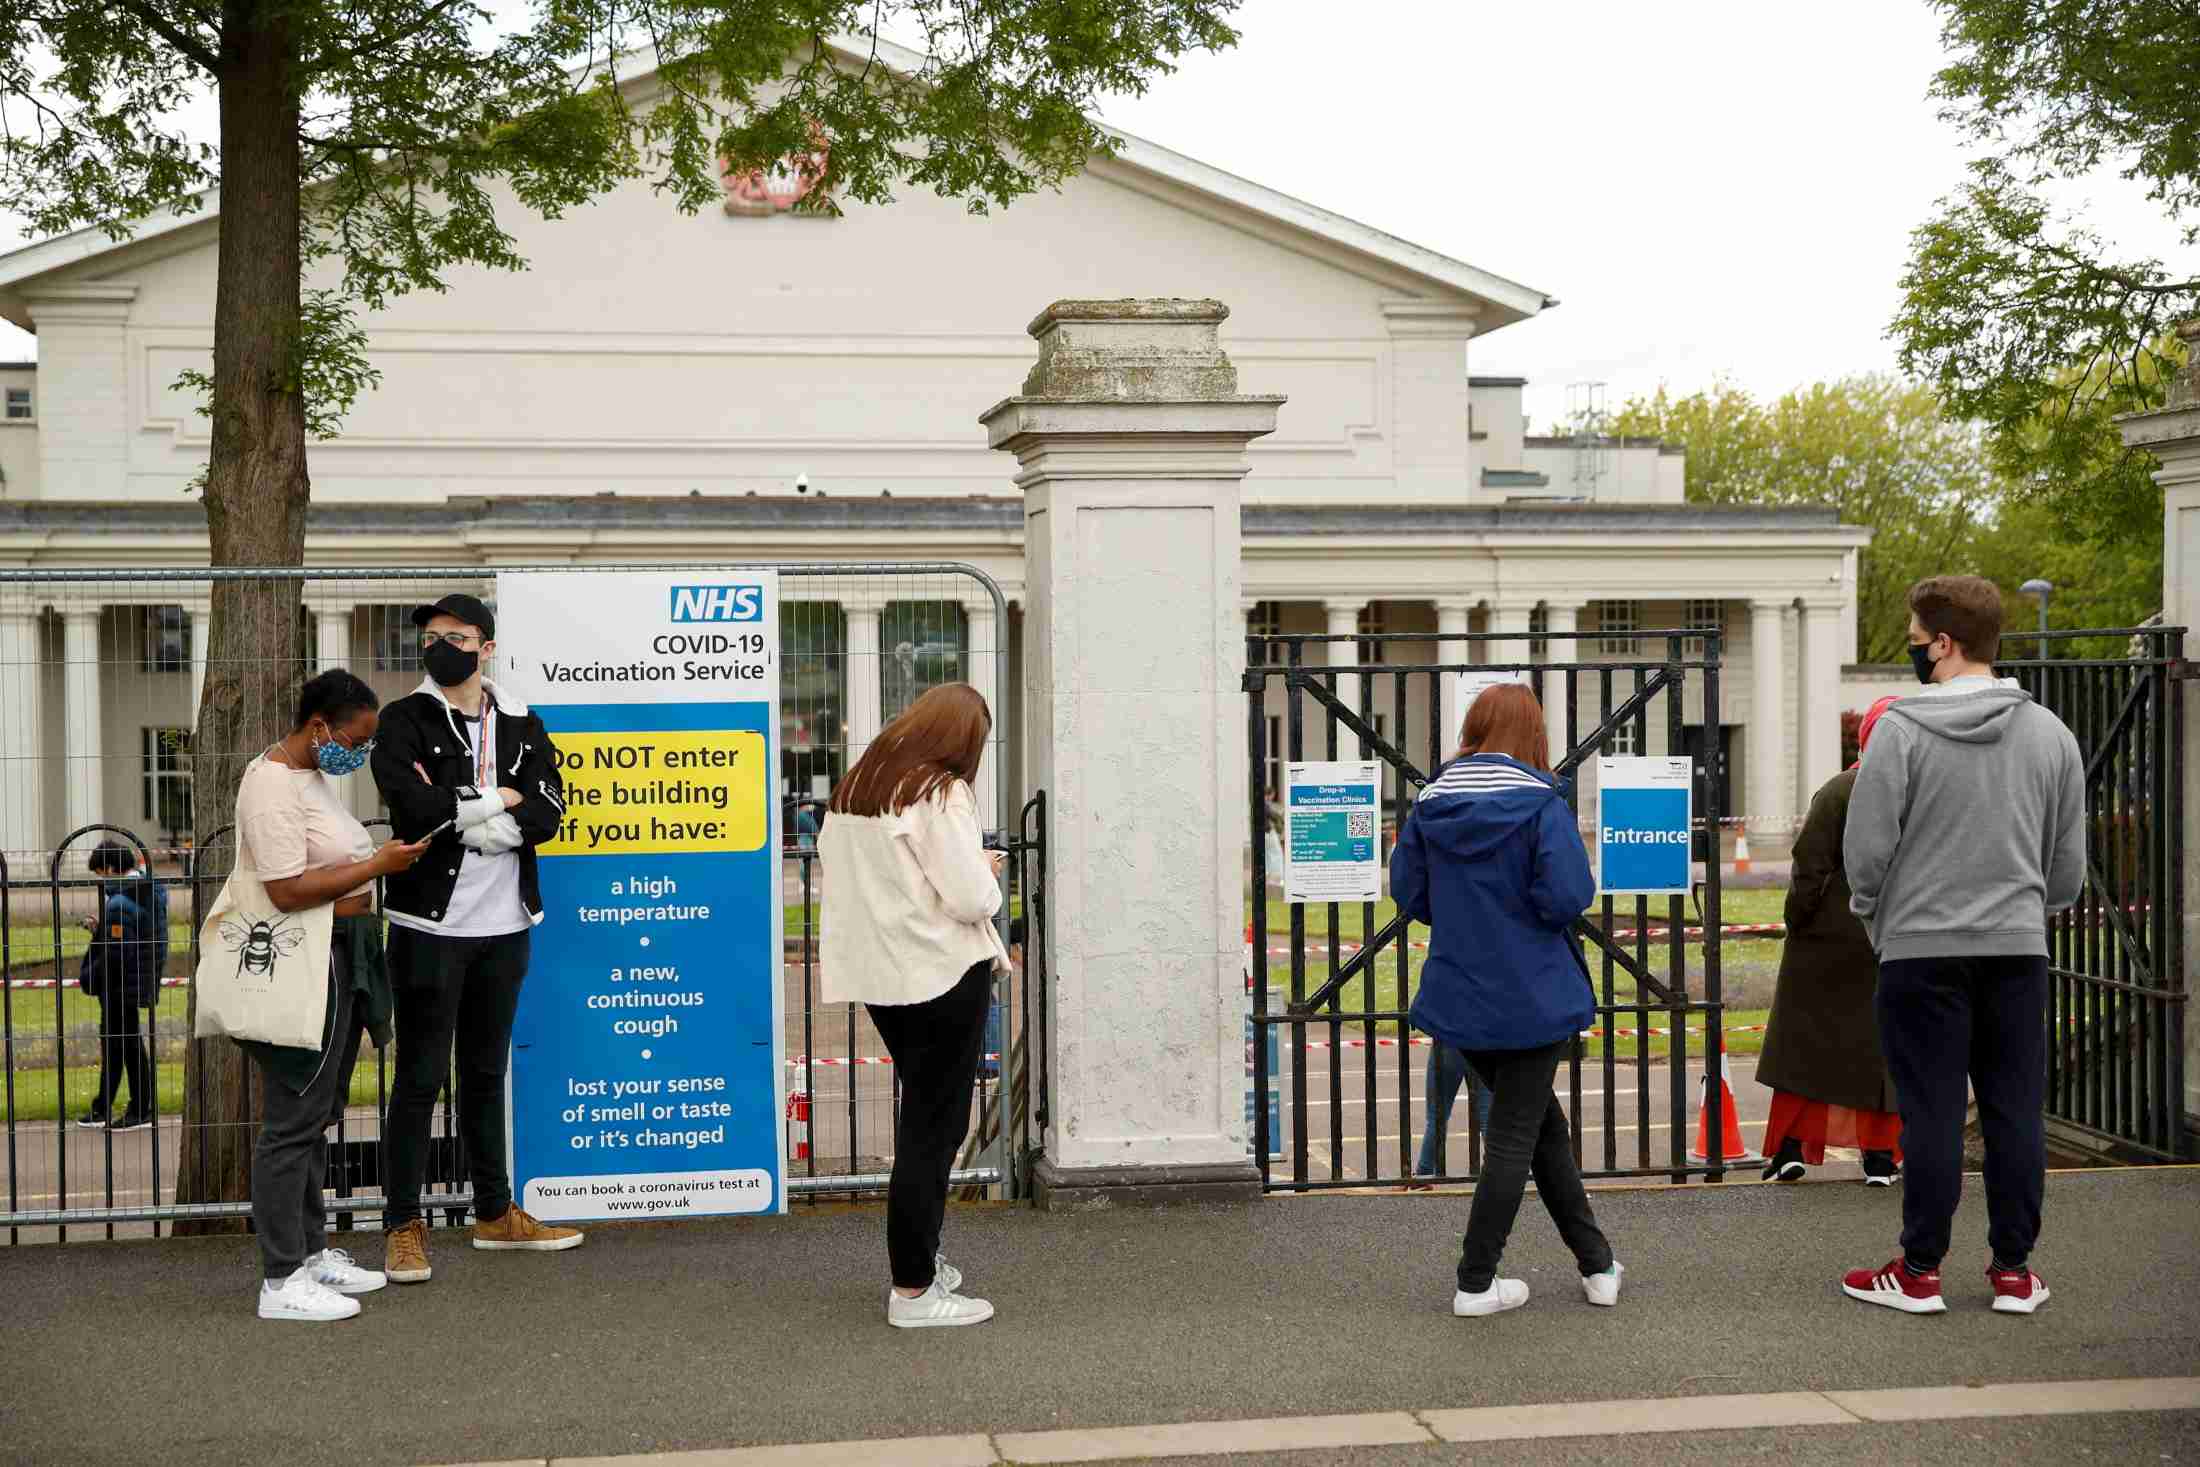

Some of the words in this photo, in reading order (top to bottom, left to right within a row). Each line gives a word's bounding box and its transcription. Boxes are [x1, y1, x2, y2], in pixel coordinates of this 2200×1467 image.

[672, 587, 758, 620] NHS
[653, 634, 764, 654] COVID-19
[542, 661, 675, 682] Vaccination
[684, 659, 764, 681] Service
[594, 746, 655, 768] NOT
[664, 743, 738, 767] enter
[562, 782, 601, 806] the
[612, 780, 728, 809] building
[1298, 796, 1340, 805] Vaccination
[1342, 795, 1367, 804] Clinics
[560, 817, 578, 842] if
[588, 822, 640, 848] you
[651, 816, 726, 841] have:
[1602, 827, 1688, 844] Entrance
[611, 881, 623, 895] a
[630, 876, 677, 898] high
[578, 905, 710, 925] temperature
[610, 968, 622, 981] a
[630, 966, 680, 982] new,
[587, 990, 704, 1008] continuous
[613, 1015, 678, 1037] cough
[568, 1079, 607, 1096] lost
[613, 1080, 661, 1099] your
[667, 1076, 726, 1093] sense
[563, 1104, 585, 1123] of
[591, 1103, 644, 1122] smell
[652, 1105, 674, 1120] or
[680, 1101, 732, 1118] taste
[571, 1134, 593, 1149] or
[635, 1125, 724, 1149] changed
[536, 1186, 561, 1197] You
[565, 1185, 587, 1196] can
[591, 1182, 624, 1195] book
[628, 1185, 636, 1194] a
[640, 1180, 715, 1194] coronavirus
[719, 1178, 743, 1191] test
[747, 1178, 759, 1189] at
[607, 1197, 690, 1211] www.gov.uk
